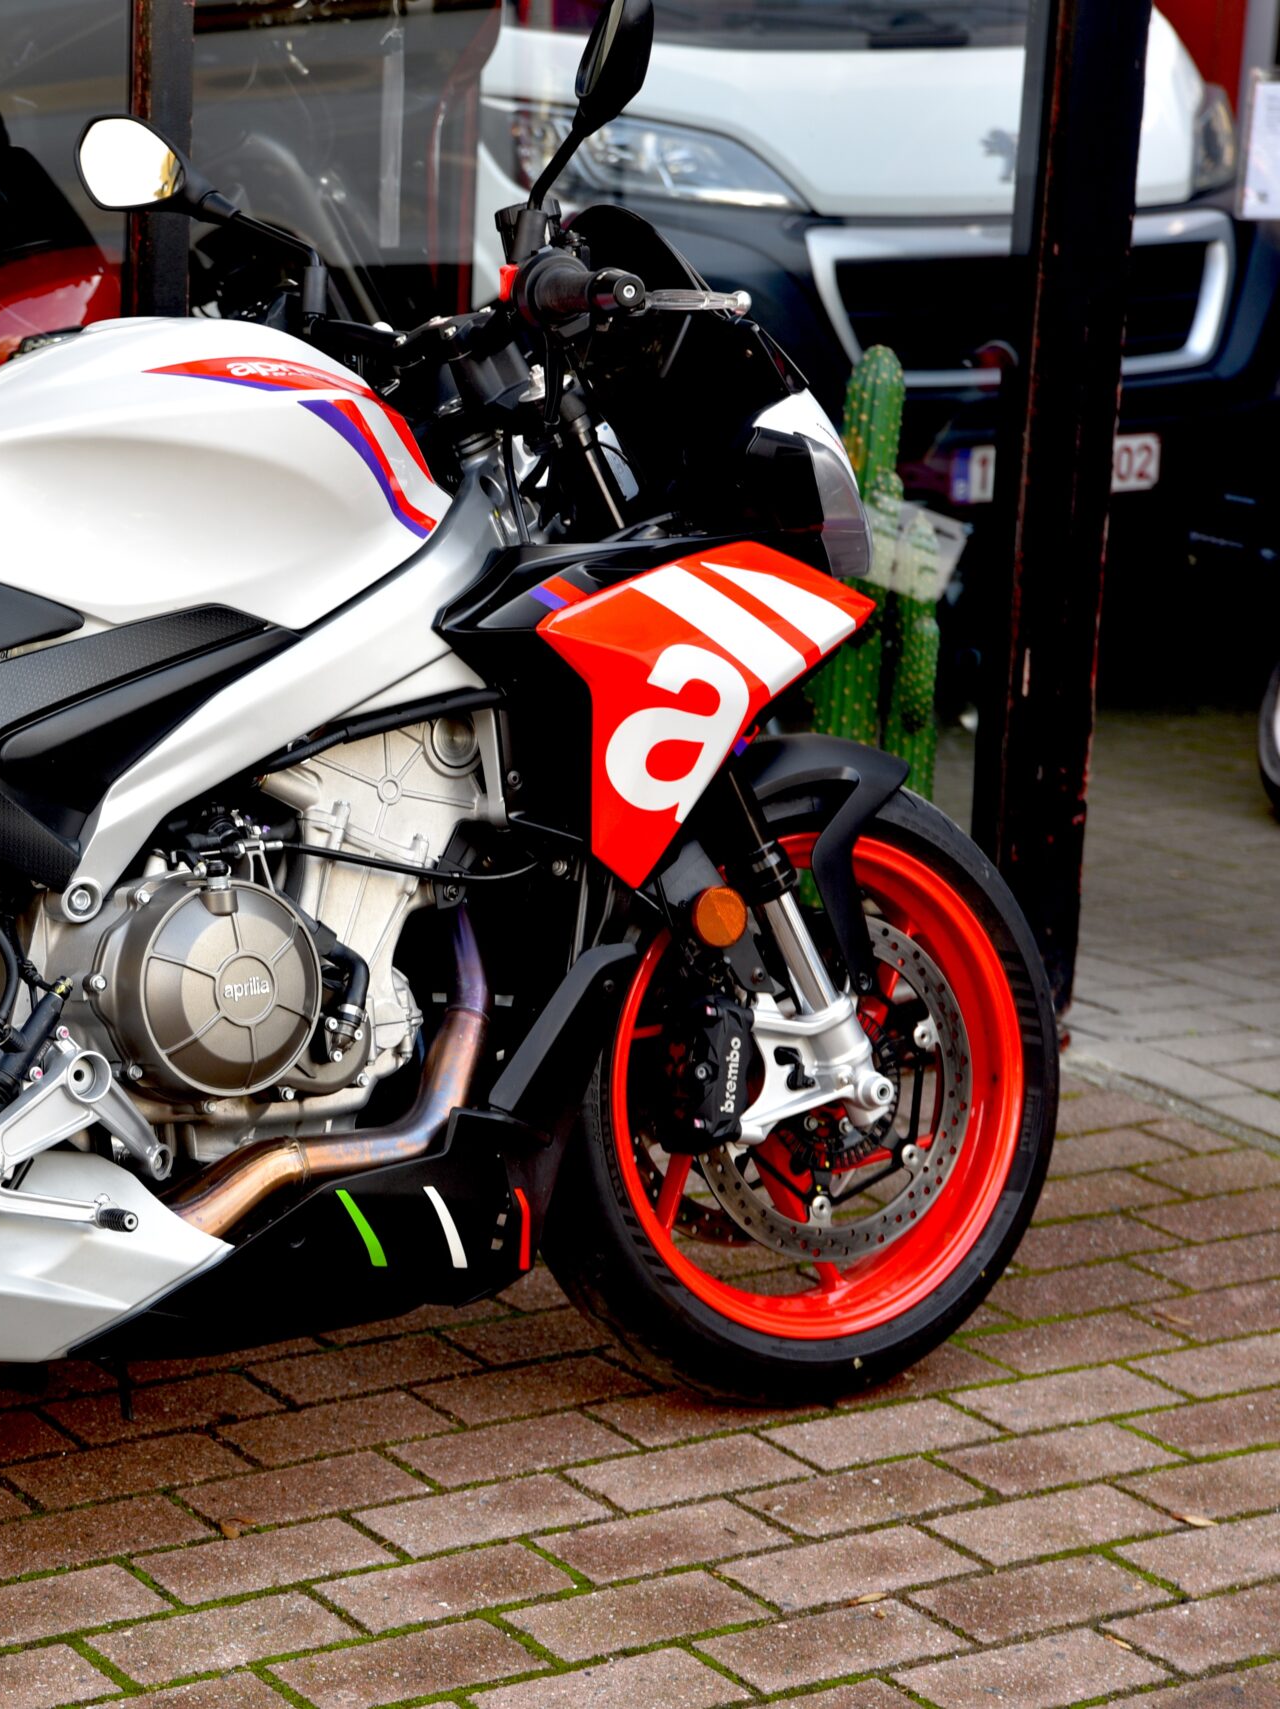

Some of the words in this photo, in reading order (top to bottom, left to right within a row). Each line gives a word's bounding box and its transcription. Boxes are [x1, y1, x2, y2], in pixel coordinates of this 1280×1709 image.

[1116, 445, 1153, 481] 02
[224, 976, 270, 1002] aprilia
[720, 1037, 742, 1113] brembo
